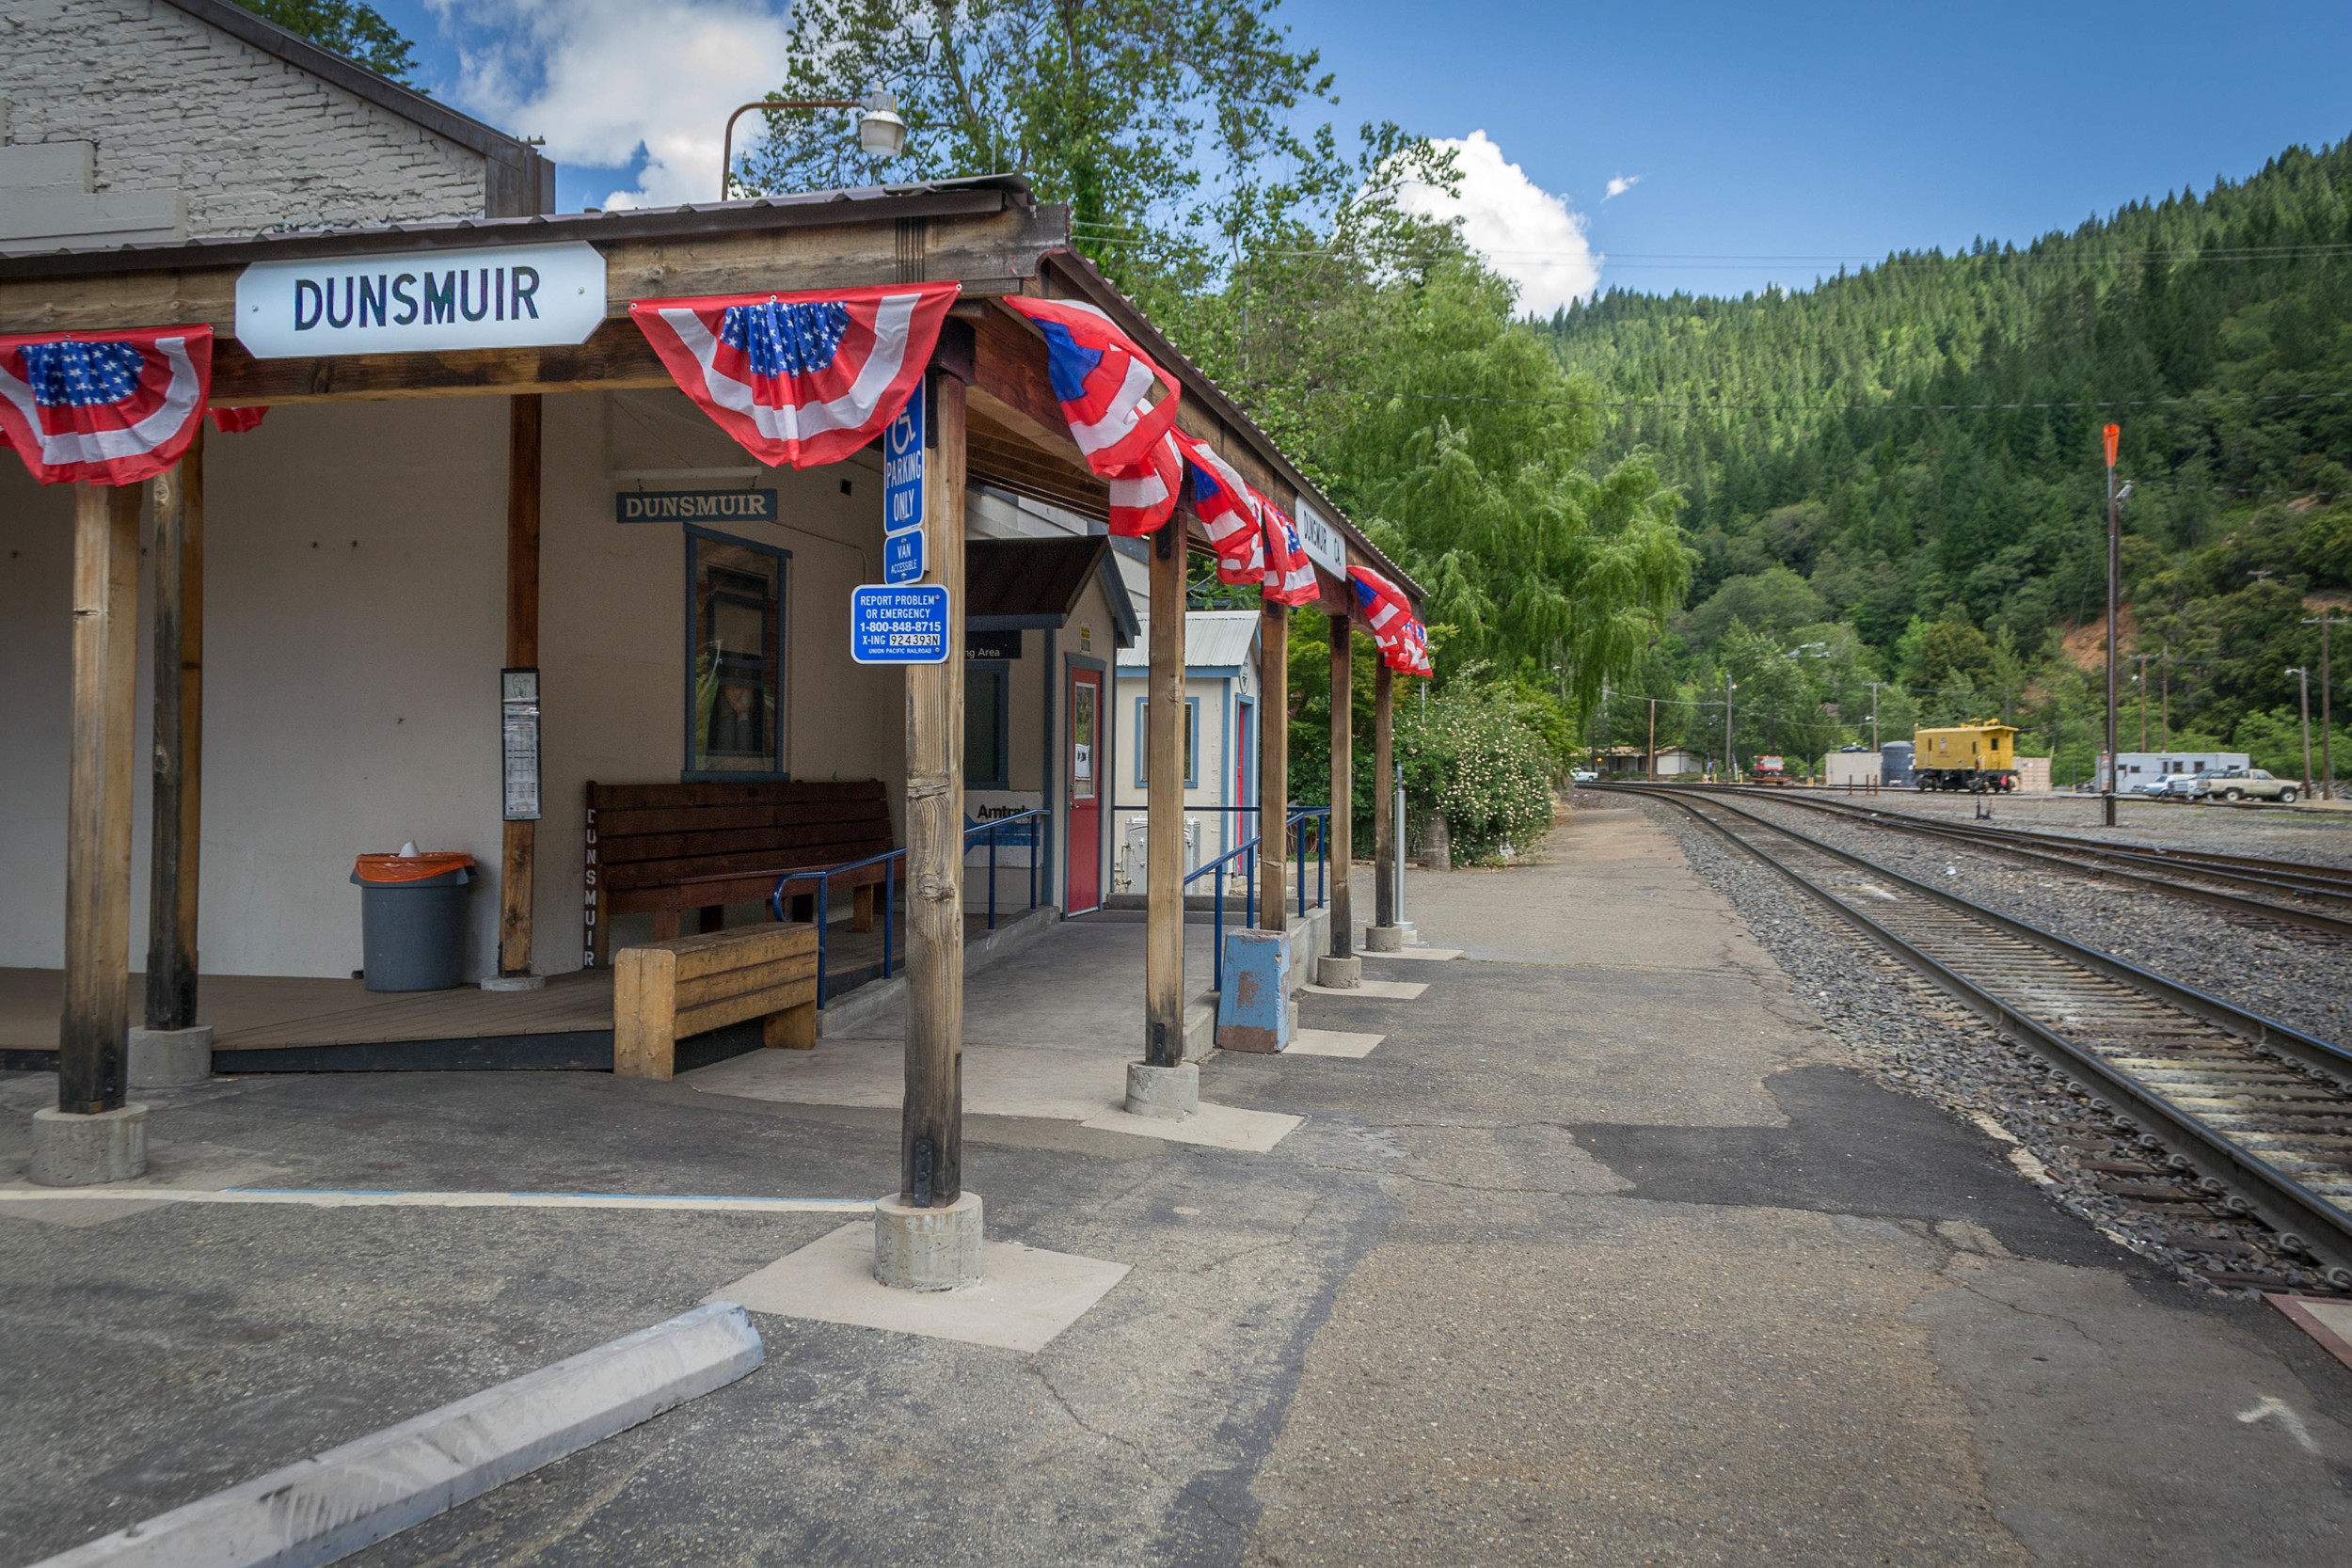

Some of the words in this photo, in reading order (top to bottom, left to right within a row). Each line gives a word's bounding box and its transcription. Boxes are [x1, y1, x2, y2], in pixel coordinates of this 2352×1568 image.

[294, 266, 541, 331] DUNSMUIR
[886, 450, 921, 489] PARKING
[626, 494, 768, 517] DUNSMUIR
[893, 488, 914, 522] ONLY
[897, 543, 912, 560] VAN
[891, 559, 917, 575] ACCESSIBLE
[860, 595, 893, 606] REPORT
[895, 594, 935, 605] PROBLEM
[866, 609, 878, 619] OR
[880, 608, 930, 619] EMERGENCY
[860, 621, 941, 632] 1-800-848-8715
[862, 635, 886, 645] X-ING
[890, 634, 939, 645] 924393N
[978, 647, 1000, 657] Area
[583, 809, 597, 966] DUNSMUIR
